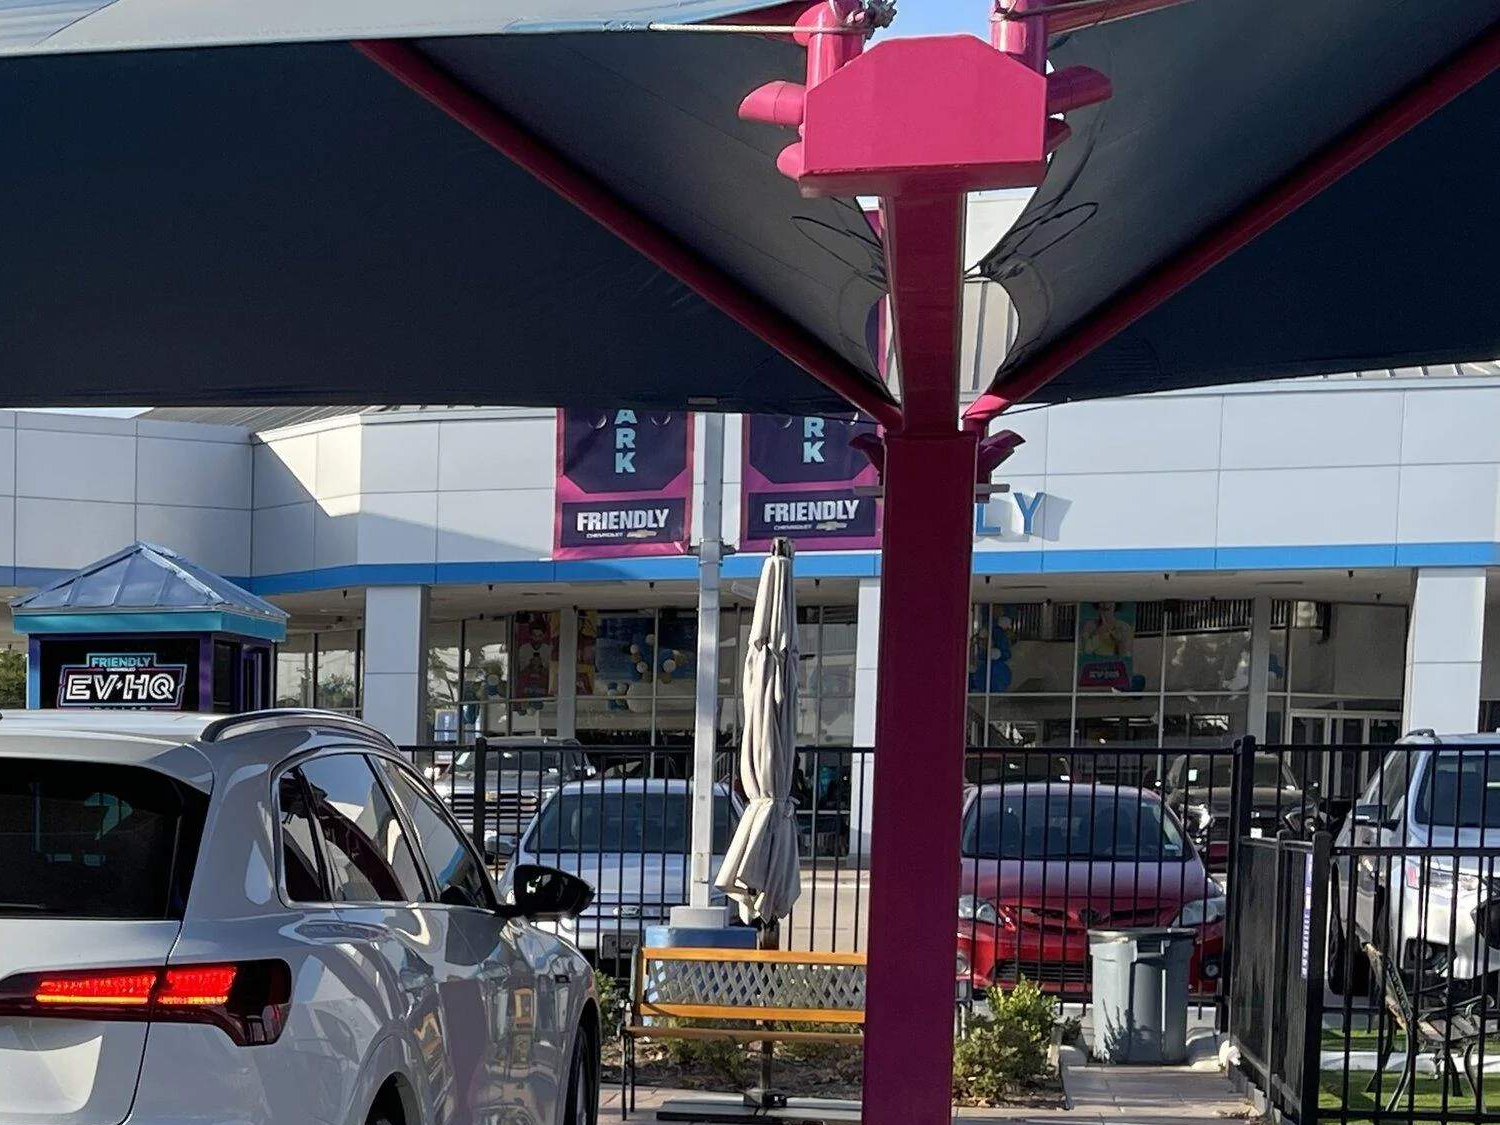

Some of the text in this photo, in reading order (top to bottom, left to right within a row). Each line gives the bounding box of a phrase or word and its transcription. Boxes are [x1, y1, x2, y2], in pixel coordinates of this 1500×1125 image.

[577, 508, 670, 532] FRIENDLY
[763, 499, 860, 523] FRIENDLY
[91, 656, 152, 668] FRIENDLY
